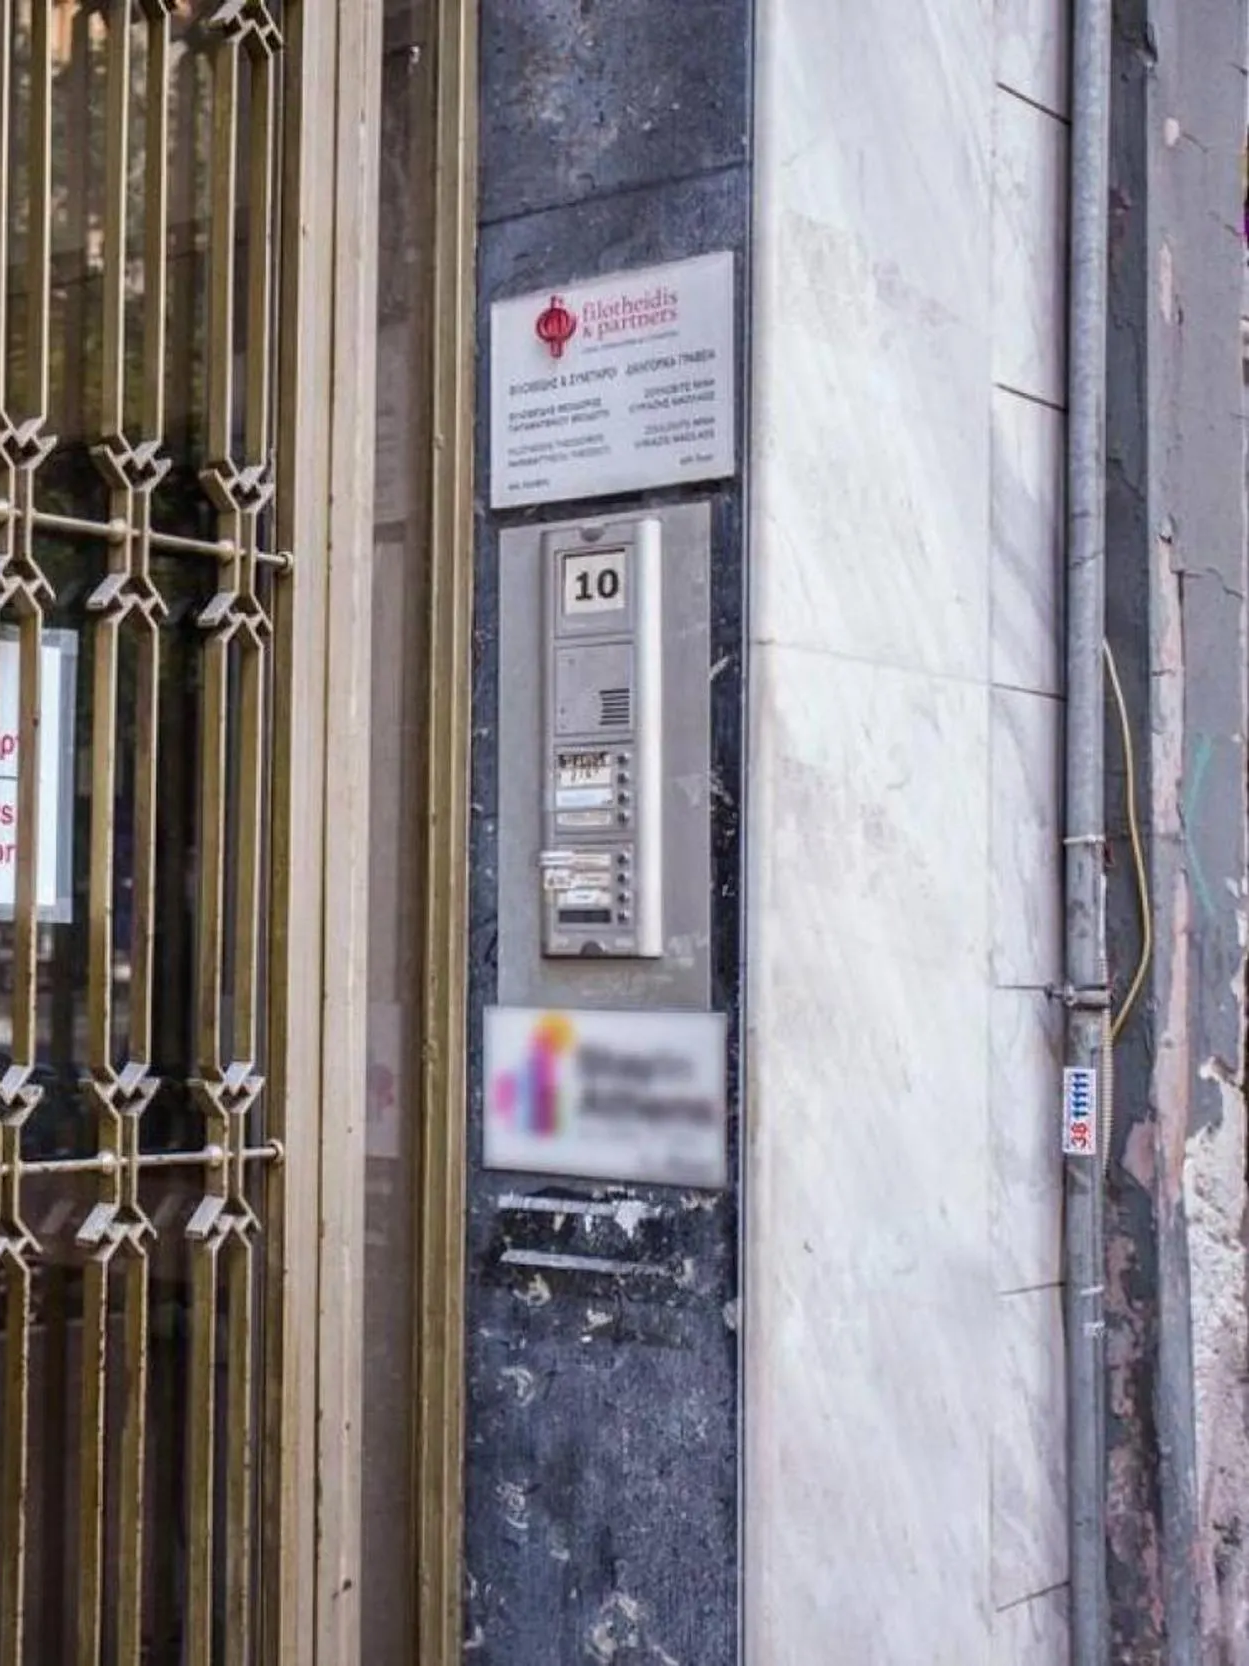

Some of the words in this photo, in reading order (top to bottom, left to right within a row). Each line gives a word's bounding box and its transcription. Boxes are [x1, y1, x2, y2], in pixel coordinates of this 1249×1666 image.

[582, 286, 678, 322] filotheidis
[597, 308, 678, 341] partners
[575, 568, 620, 601] 10
